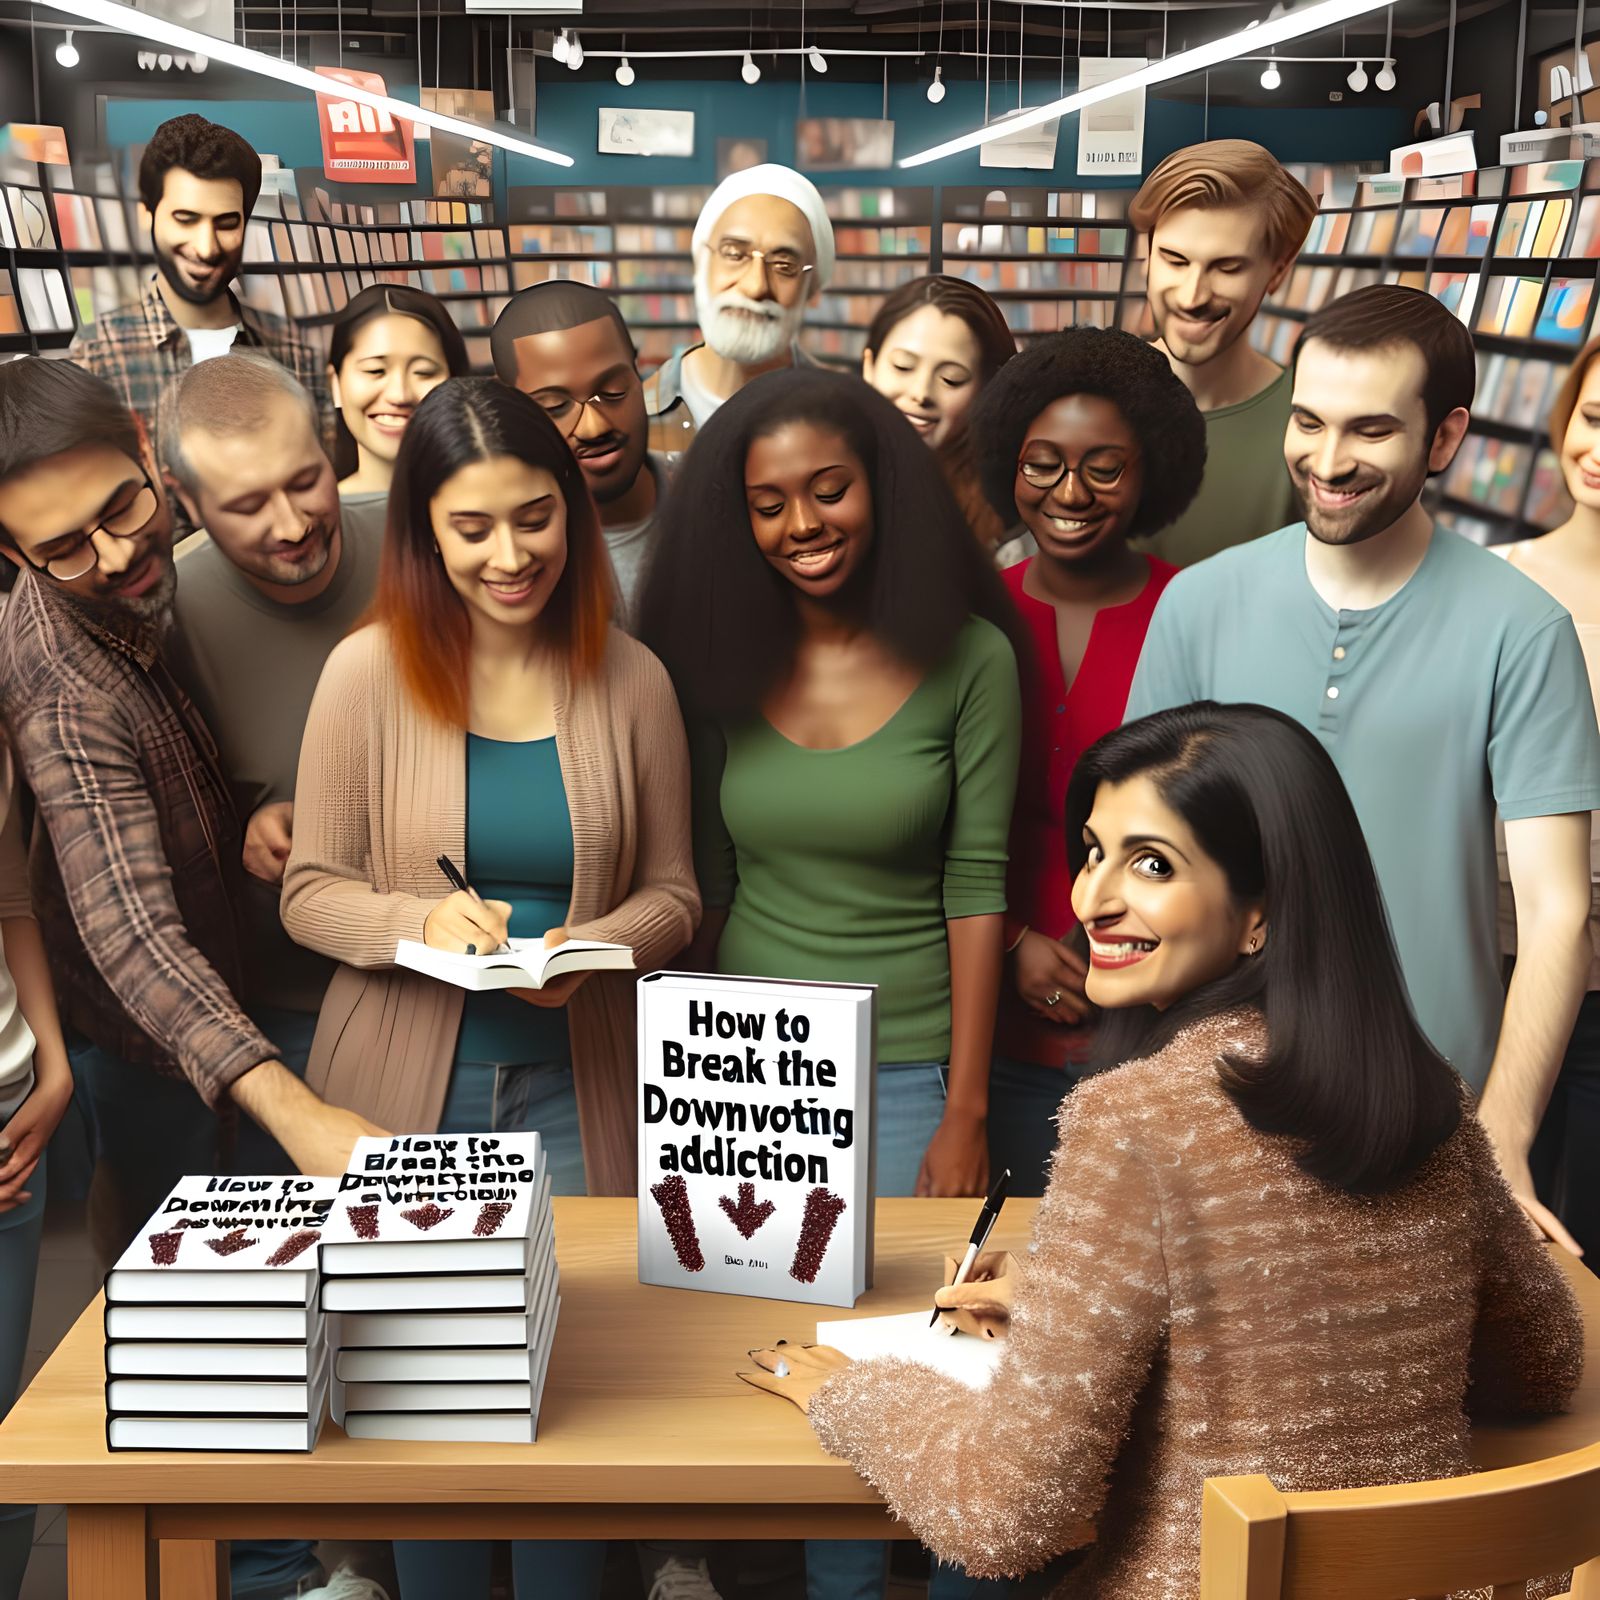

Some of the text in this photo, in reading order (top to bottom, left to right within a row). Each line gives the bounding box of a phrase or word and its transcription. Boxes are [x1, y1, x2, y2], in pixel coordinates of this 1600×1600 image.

[689, 999, 811, 1044] How to
[662, 1040, 837, 1088] Break the
[643, 1082, 854, 1149] Downvoting
[659, 1134, 829, 1184] addiction
